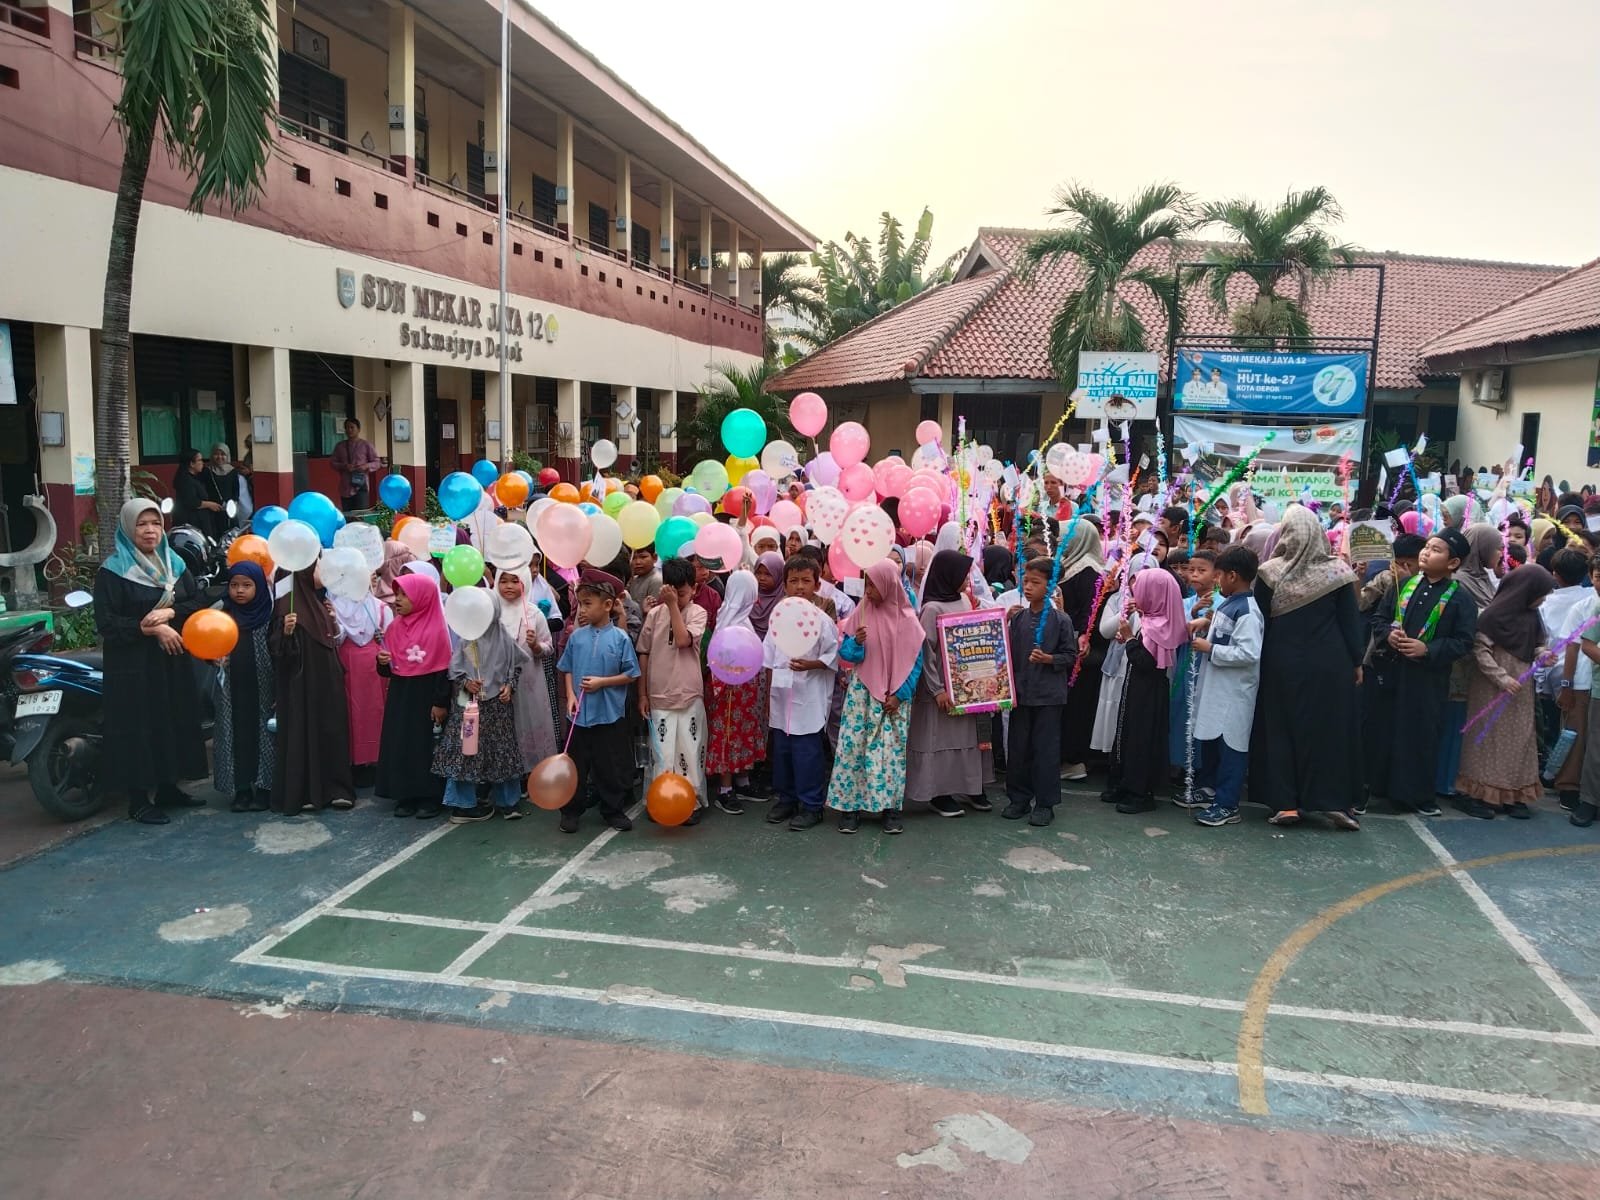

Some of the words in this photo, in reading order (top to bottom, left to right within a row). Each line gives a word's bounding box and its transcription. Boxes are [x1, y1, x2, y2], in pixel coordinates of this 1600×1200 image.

[361, 273, 407, 315] SDN
[412, 285, 482, 329] MEKAR
[527, 311, 544, 340] 12
[400, 322, 482, 361] Sukmajaya
[484, 336, 523, 362] Deok
[1221, 354, 1239, 364] SDN
[1295, 357, 1307, 365] 12
[1079, 373, 1126, 387] BASKET
[1128, 374, 1157, 388] BALL
[1237, 373, 1262, 384] HUT
[1264, 373, 1296, 385] ke-27
[1236, 384, 1255, 392] KOTA
[1256, 384, 1280, 393] DEPOK
[1312, 488, 1347, 499] DEPO
[960, 646, 994, 657] Islam
